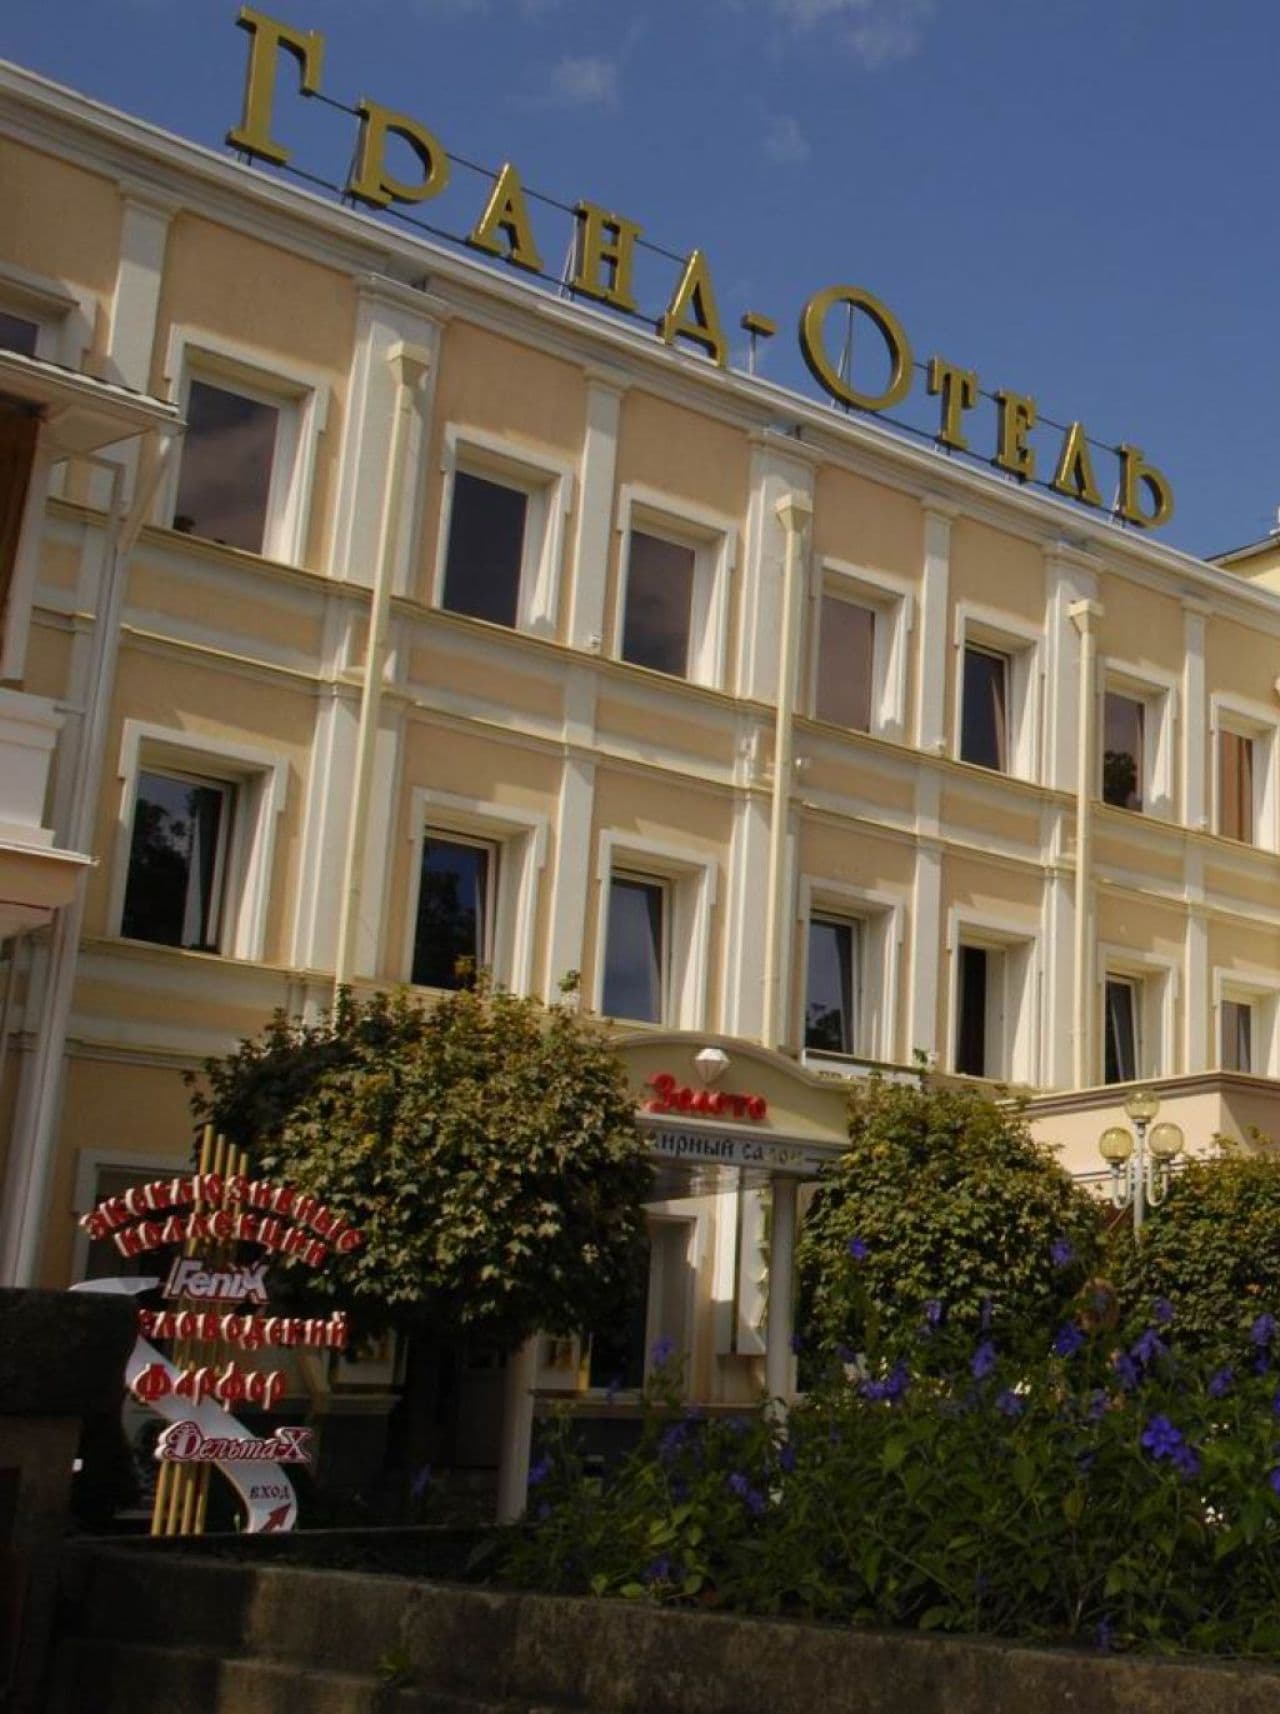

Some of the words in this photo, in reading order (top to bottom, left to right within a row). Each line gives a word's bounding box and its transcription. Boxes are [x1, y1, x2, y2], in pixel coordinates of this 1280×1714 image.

[645, 1073, 768, 1121] Золото
[652, 1130, 734, 1160] ирный
[131, 1360, 288, 1412] Фарфор
